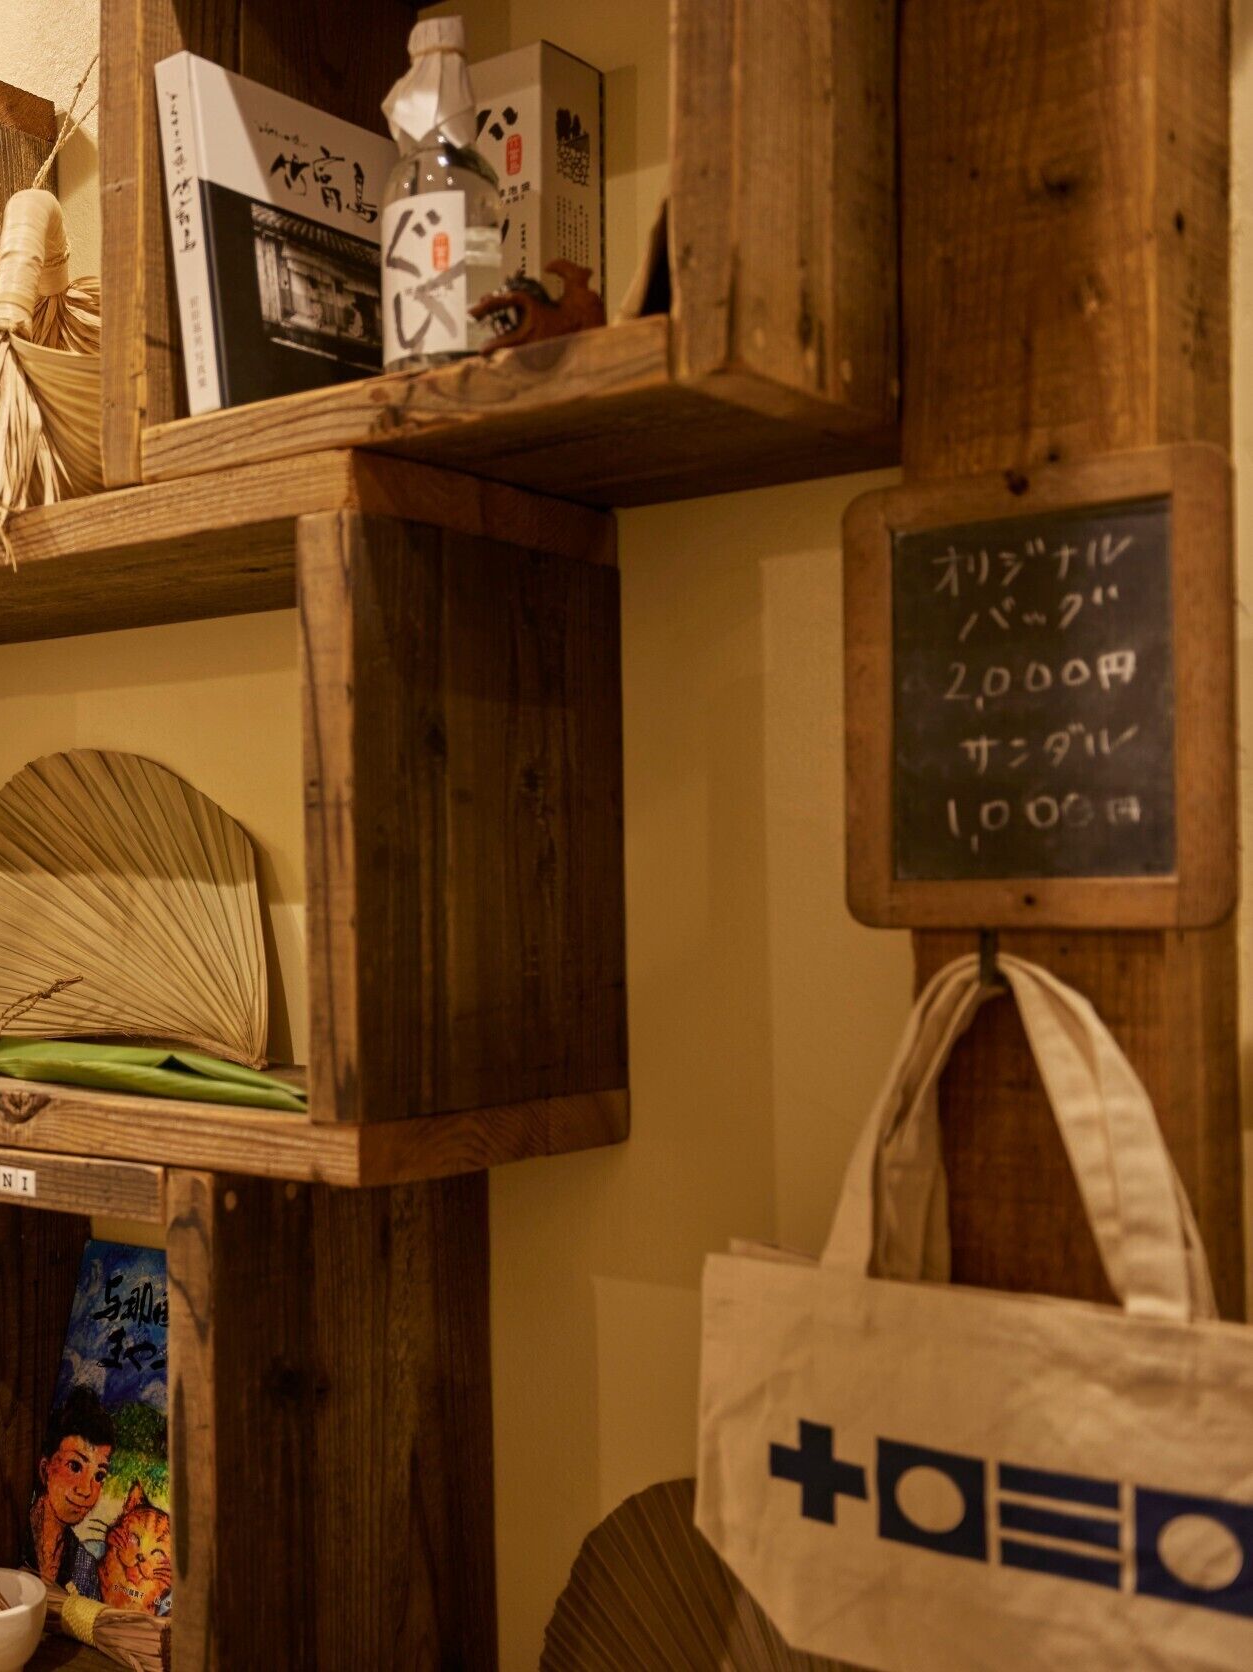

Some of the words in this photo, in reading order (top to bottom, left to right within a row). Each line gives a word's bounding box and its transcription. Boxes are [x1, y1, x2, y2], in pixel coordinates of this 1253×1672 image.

[269, 145, 378, 224] 竹富島
[931, 532, 1134, 597] オリジナル
[958, 583, 1120, 643] バッグ
[944, 648, 1137, 711] 2,000円
[958, 723, 1140, 775] サンダル
[946, 792, 1142, 854] 1,000円
